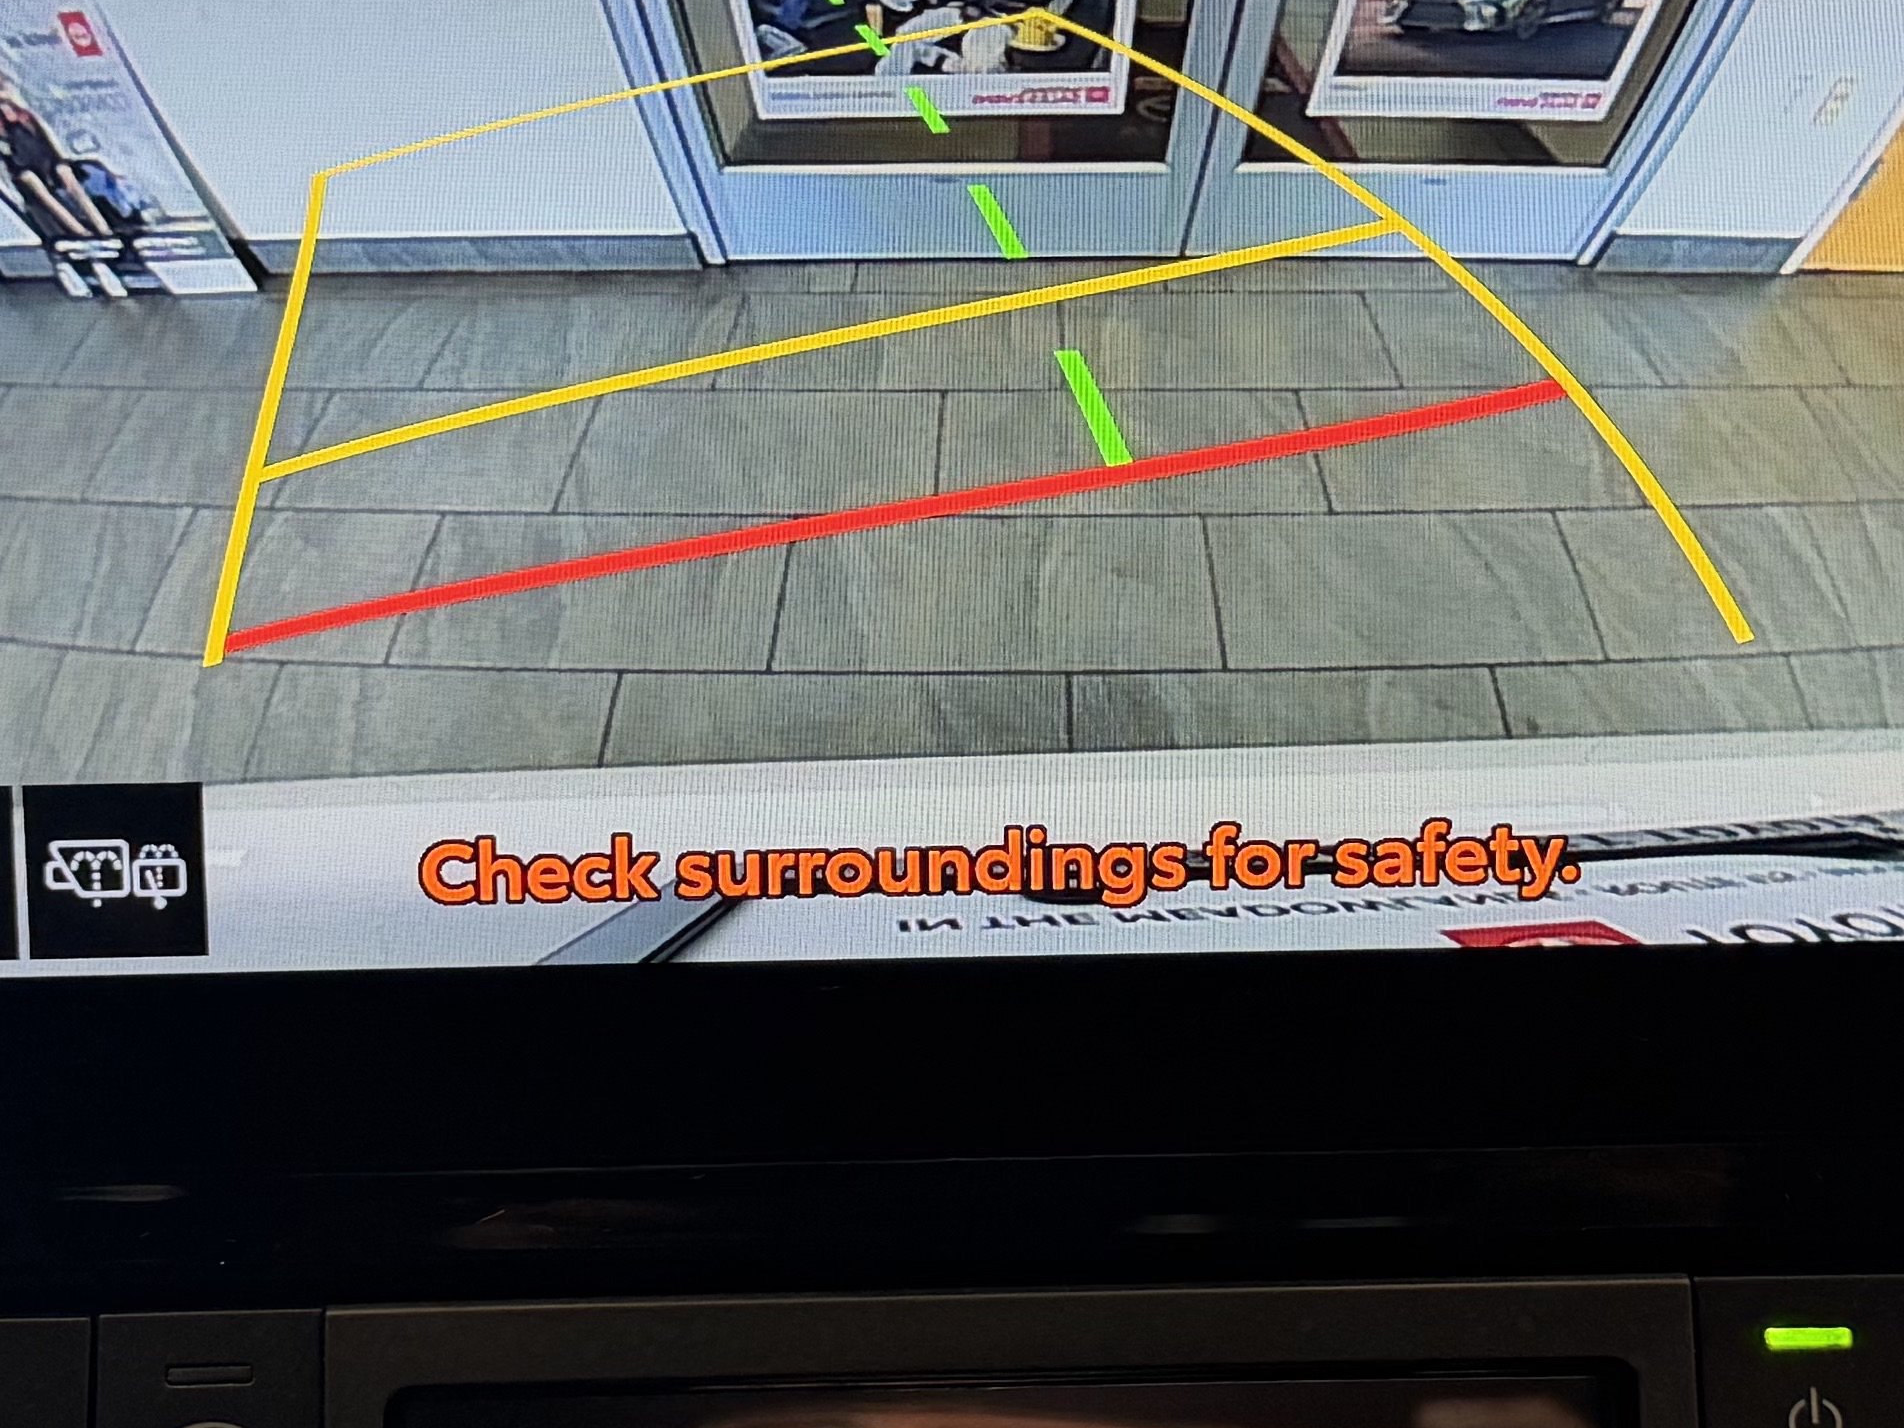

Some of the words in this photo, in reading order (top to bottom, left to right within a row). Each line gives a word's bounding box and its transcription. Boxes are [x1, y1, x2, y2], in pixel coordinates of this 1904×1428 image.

[418, 832, 662, 904] Check
[674, 824, 1188, 909] surroundings
[1202, 820, 1321, 891] for
[1332, 816, 1582, 901] safety.
